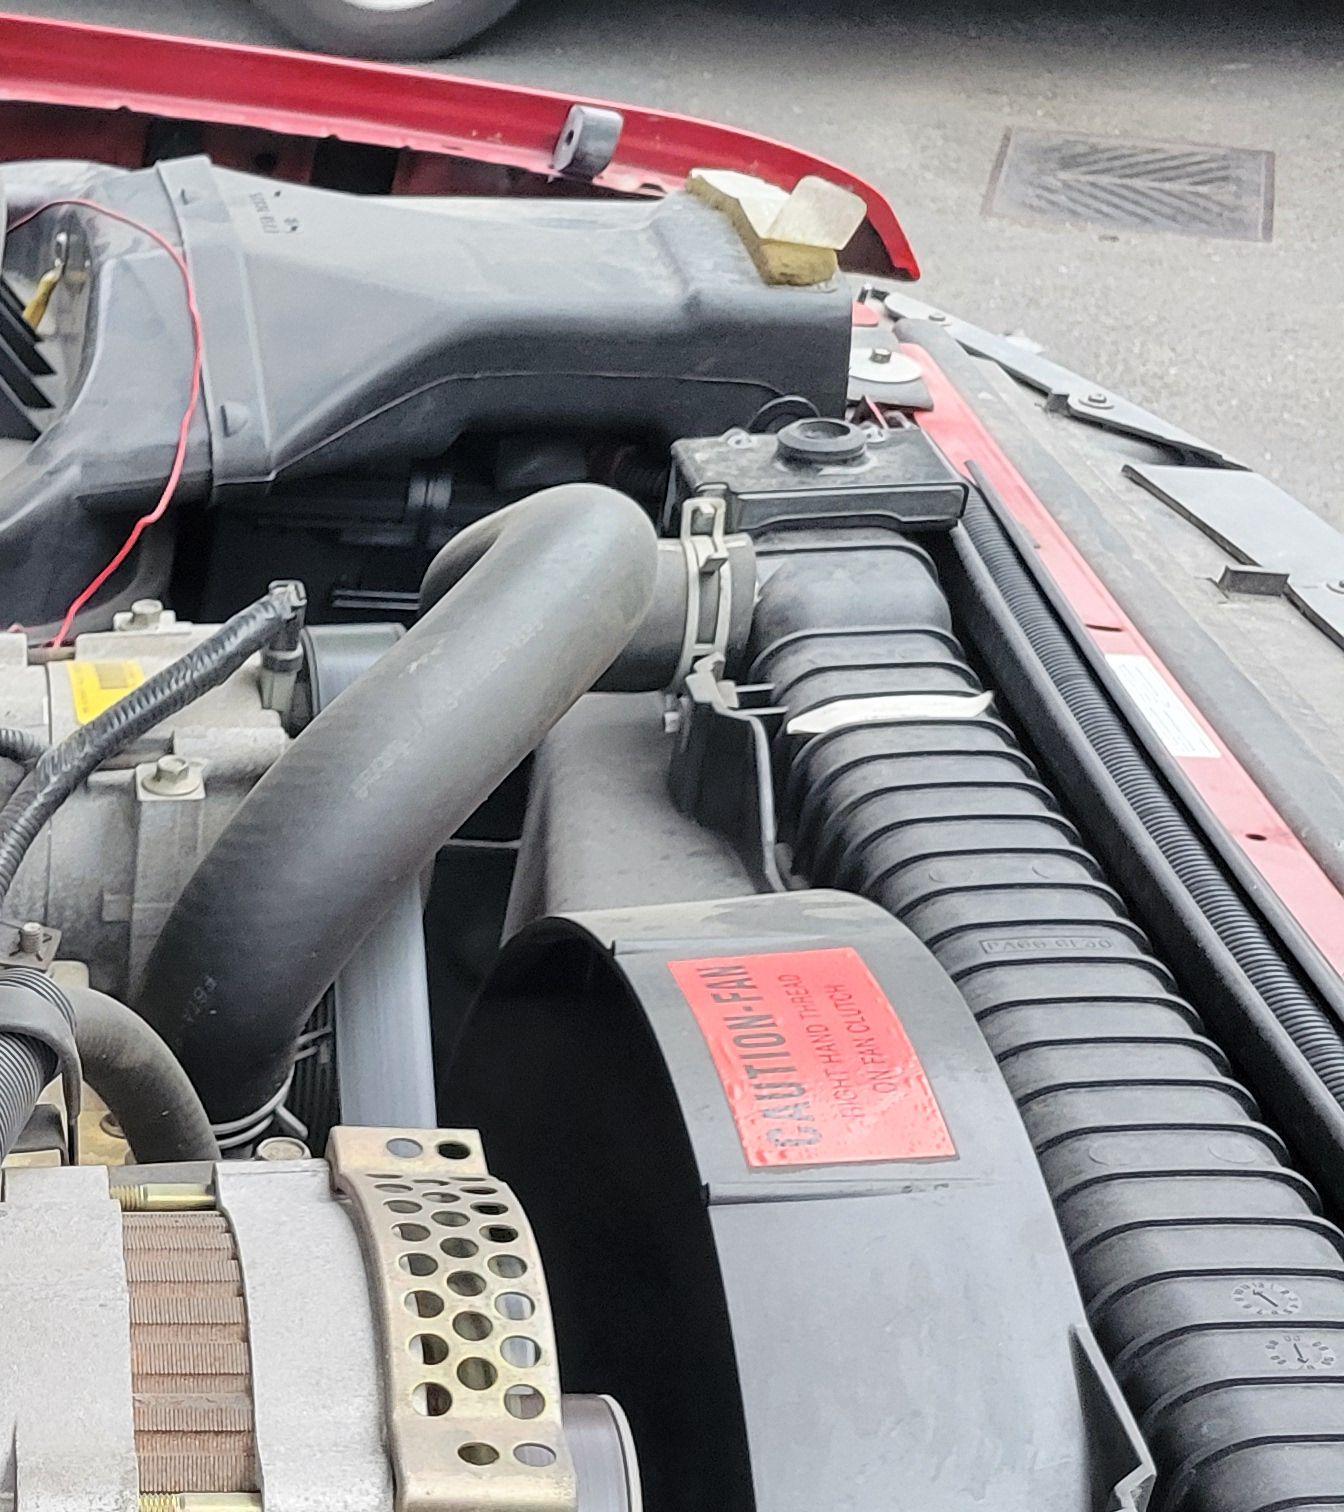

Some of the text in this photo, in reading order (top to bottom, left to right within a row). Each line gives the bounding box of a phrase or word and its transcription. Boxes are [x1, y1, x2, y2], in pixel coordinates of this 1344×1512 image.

[777, 973, 822, 1021] THREAD
[805, 1023, 841, 1067] HAND
[823, 983, 898, 1095] ON FAN CLUTCH
